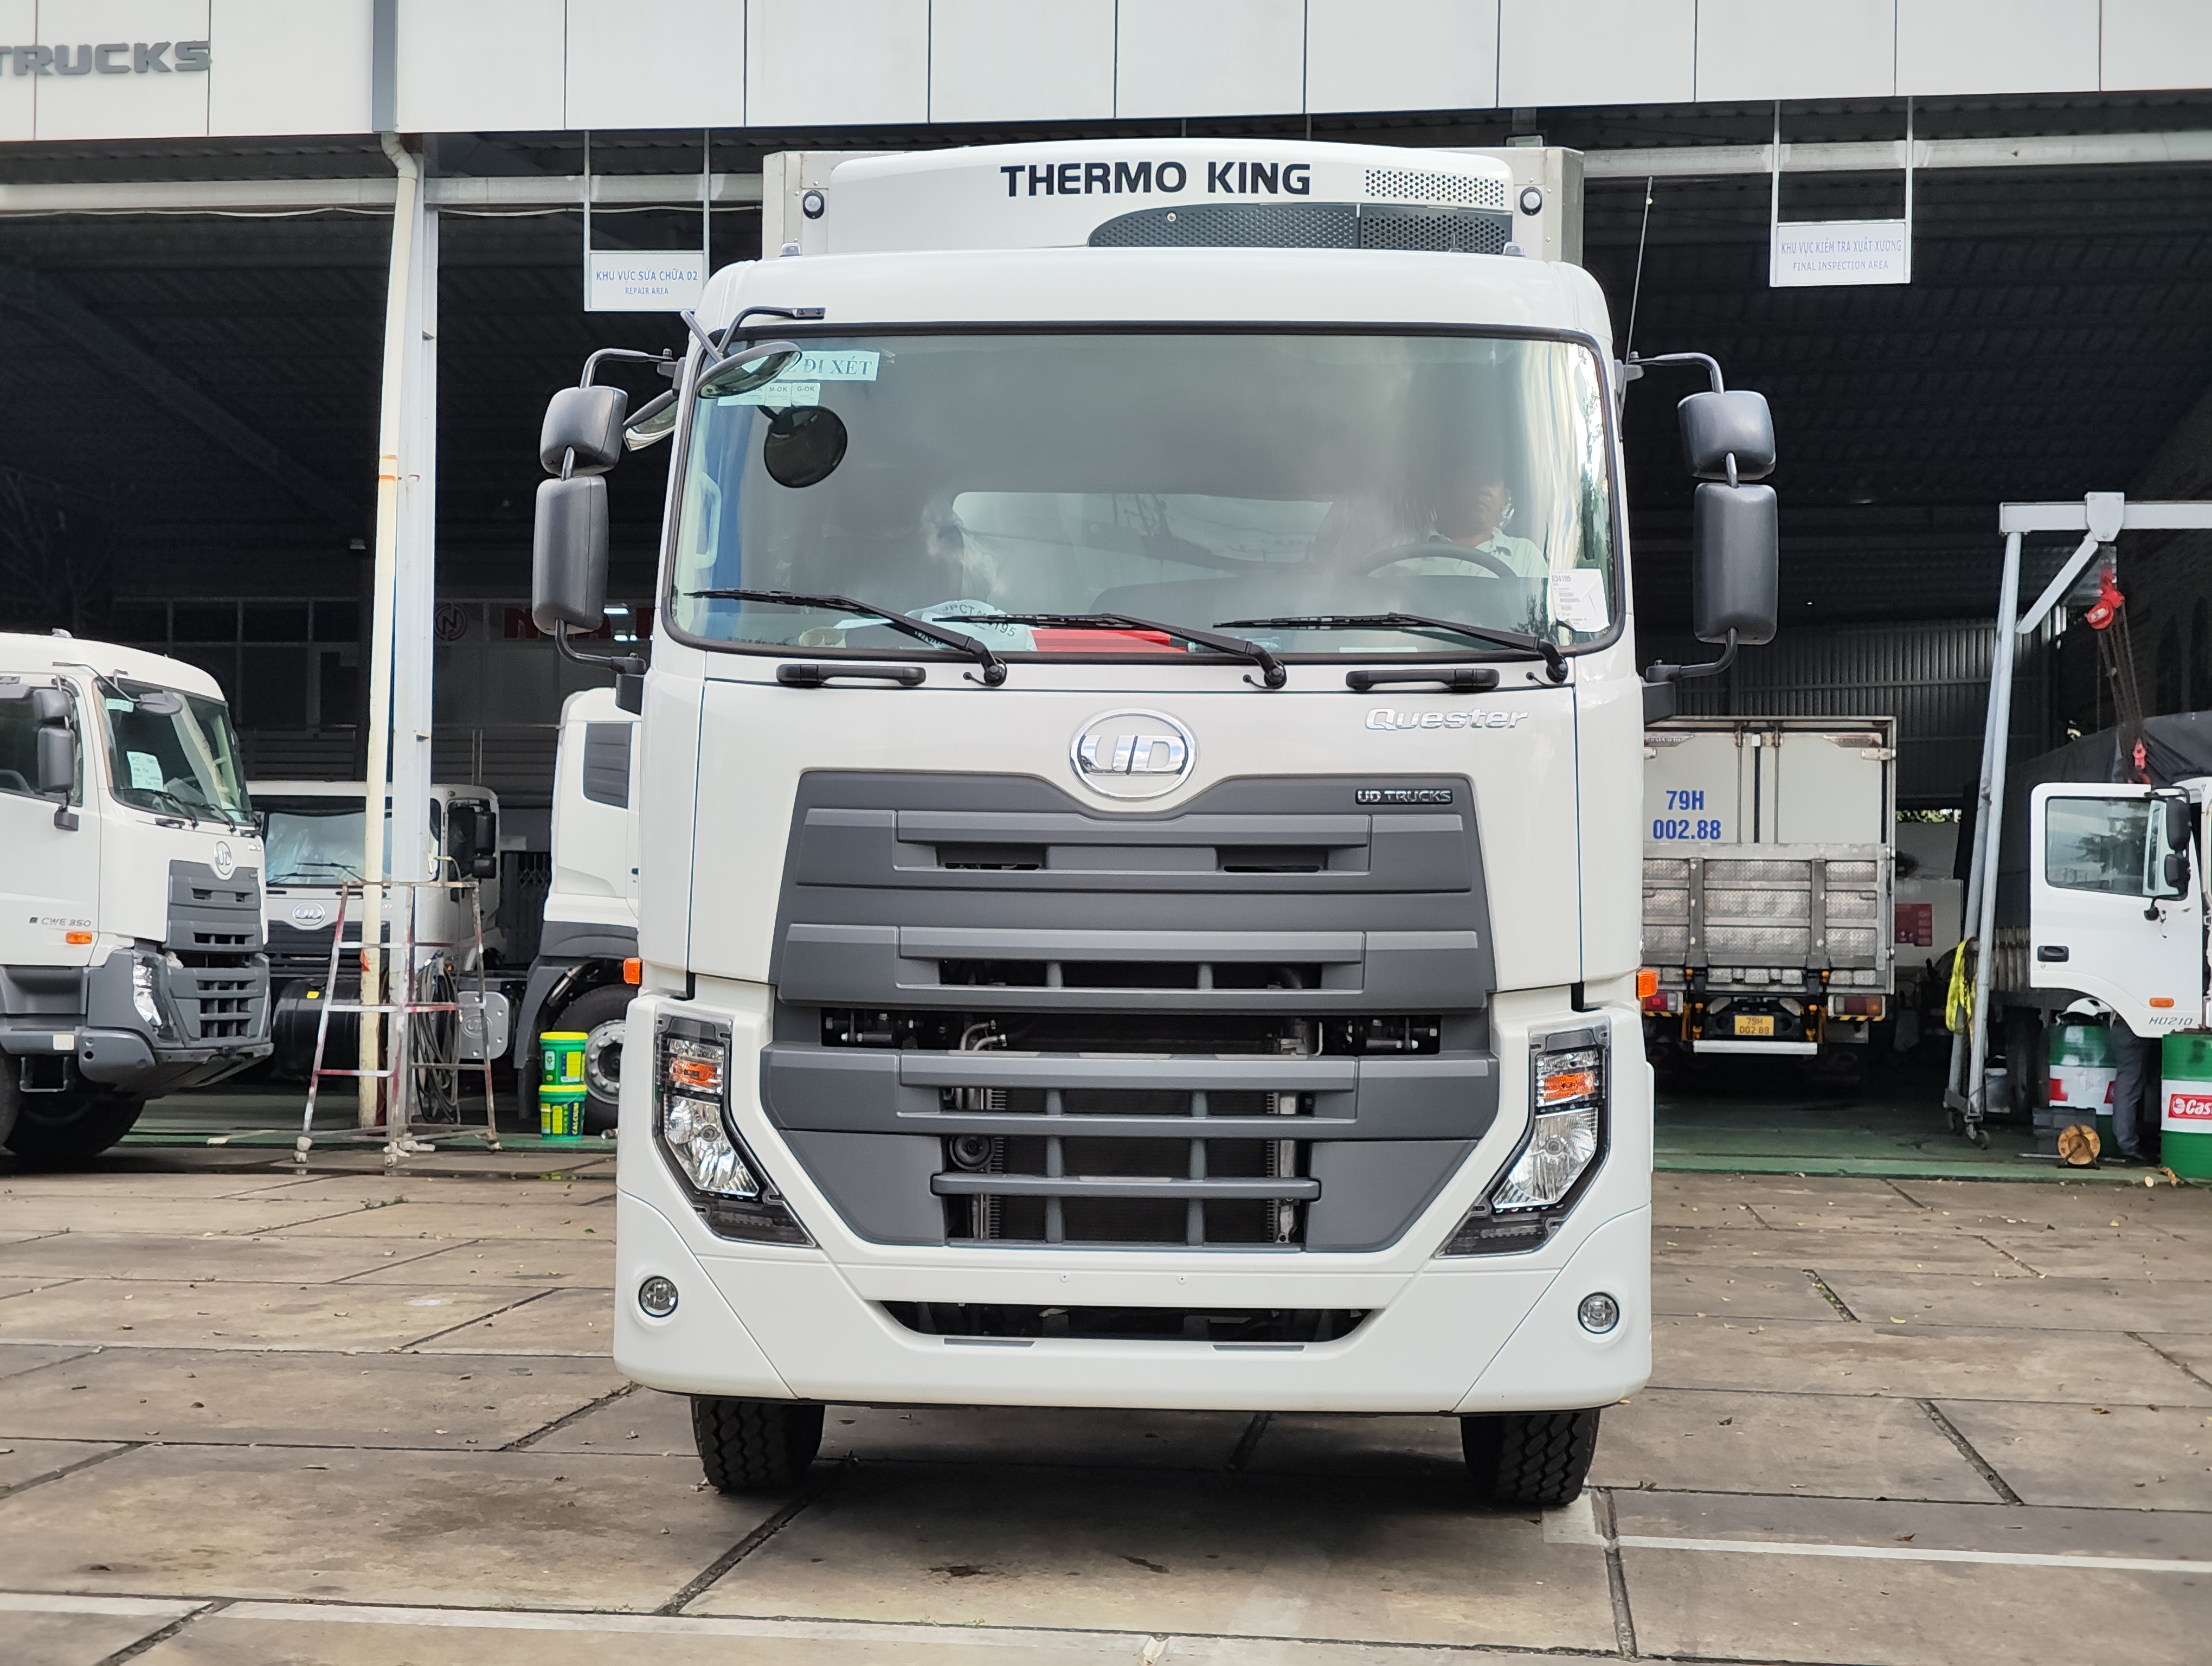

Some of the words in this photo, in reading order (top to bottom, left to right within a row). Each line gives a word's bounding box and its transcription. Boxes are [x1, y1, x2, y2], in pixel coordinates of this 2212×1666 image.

[1000, 162, 1187, 197] THERMO
[1207, 162, 1310, 195] KING
[1782, 241, 1797, 254] KHU
[1837, 241, 1850, 253] TRA
[1793, 261, 1816, 271] FINAL
[1818, 261, 1866, 271] INSPECTION
[1868, 260, 1888, 270] AREA
[596, 271, 614, 280] KHU
[618, 269, 636, 283] VỰC
[638, 267, 657, 280] SỬA
[659, 268, 684, 280] CHỮA
[687, 271, 698, 280] 02
[829, 356, 872, 375] XÉT
[1365, 708, 1529, 731] Quester
[1079, 734, 1186, 776] UD
[1357, 790, 1381, 803] UD
[1384, 790, 1451, 803] TRUCKS
[1666, 790, 1704, 810] 79H
[1653, 819, 1721, 840] 002.88
[41, 917, 67, 926] CWE
[69, 919, 92, 927] 350
[1746, 1017, 1763, 1026] 79H
[2149, 1016, 2193, 1026] HD210
[2185, 1099, 2212, 1115] Cas
